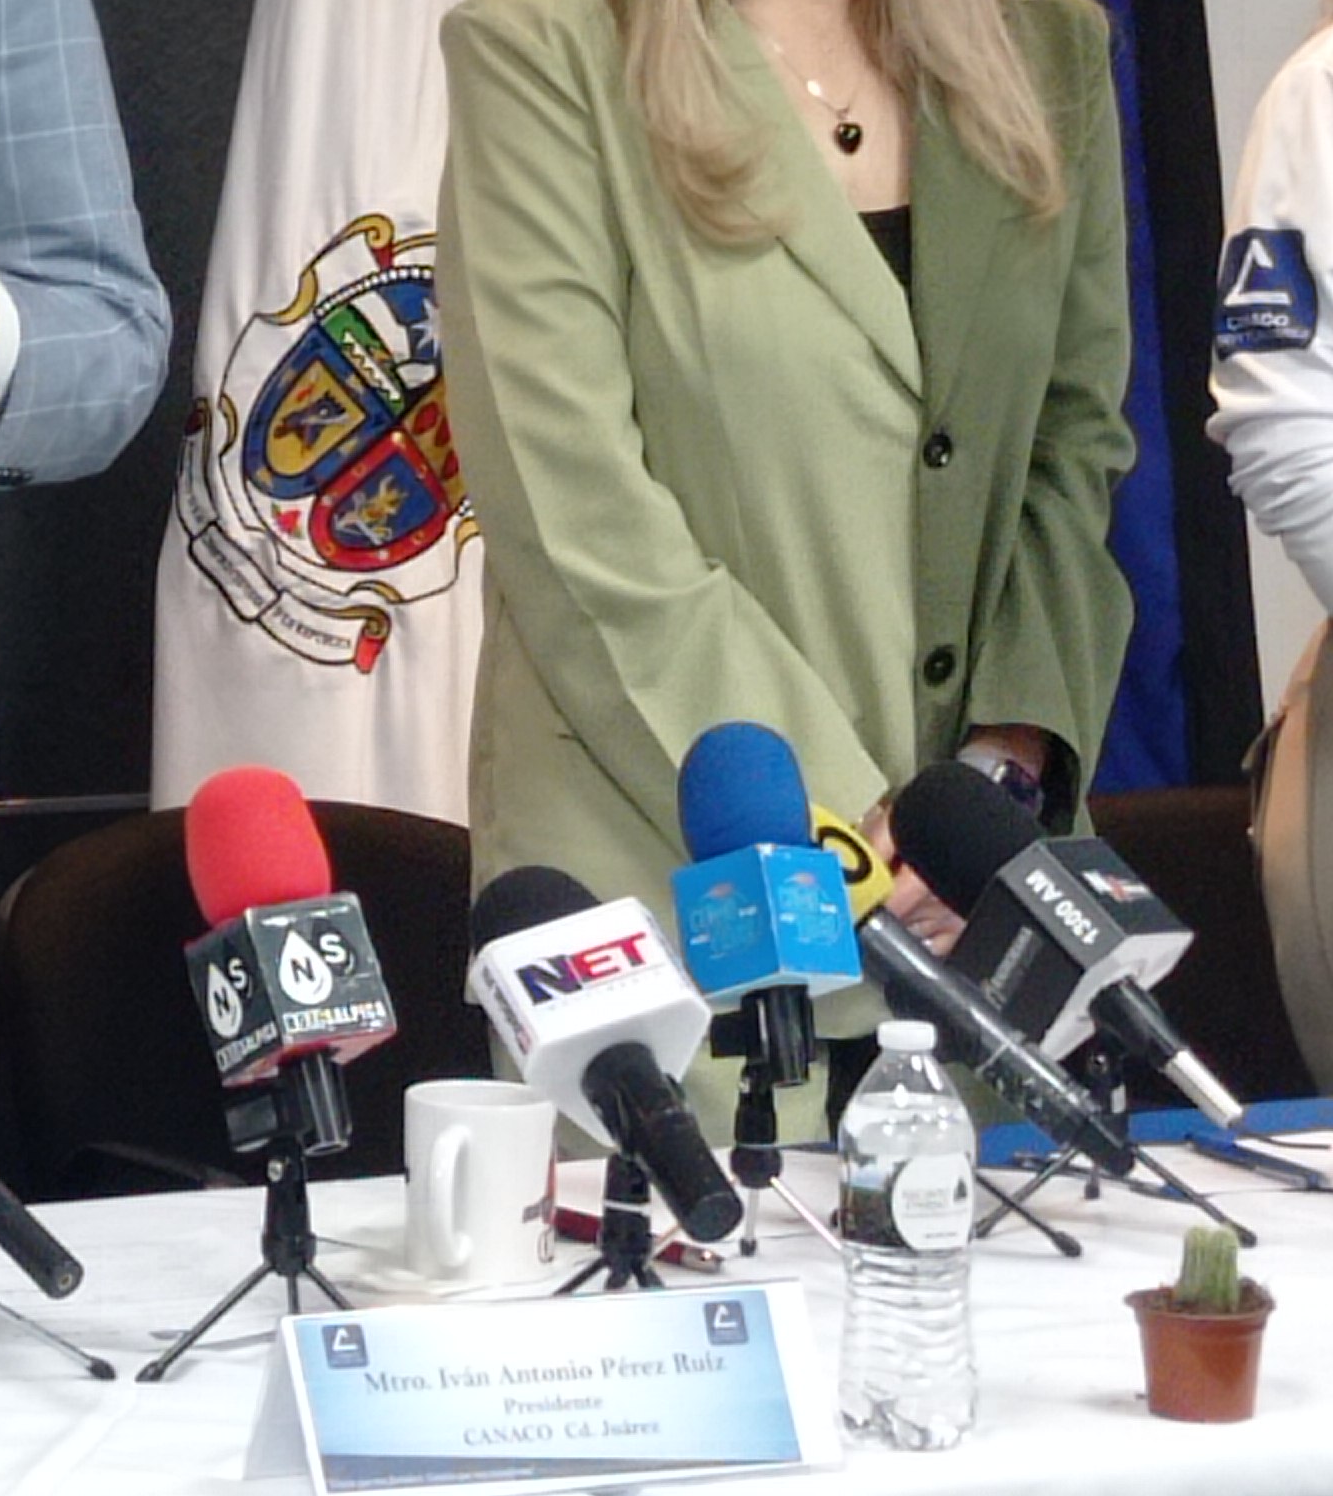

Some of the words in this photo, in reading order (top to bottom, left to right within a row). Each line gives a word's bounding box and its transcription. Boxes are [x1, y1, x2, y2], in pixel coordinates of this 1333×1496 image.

[1025, 868, 1062, 902] AM
[1054, 900, 1101, 945] 1300
[515, 931, 647, 1006] NET
[363, 1371, 432, 1395] Mtro.
[438, 1367, 490, 1390] Iván
[498, 1359, 593, 1386] Antonio
[600, 1355, 667, 1379] Pérez
[503, 1394, 604, 1416] Presidente
[463, 1423, 553, 1447] CANACO
[601, 1419, 661, 1438] Juárez
